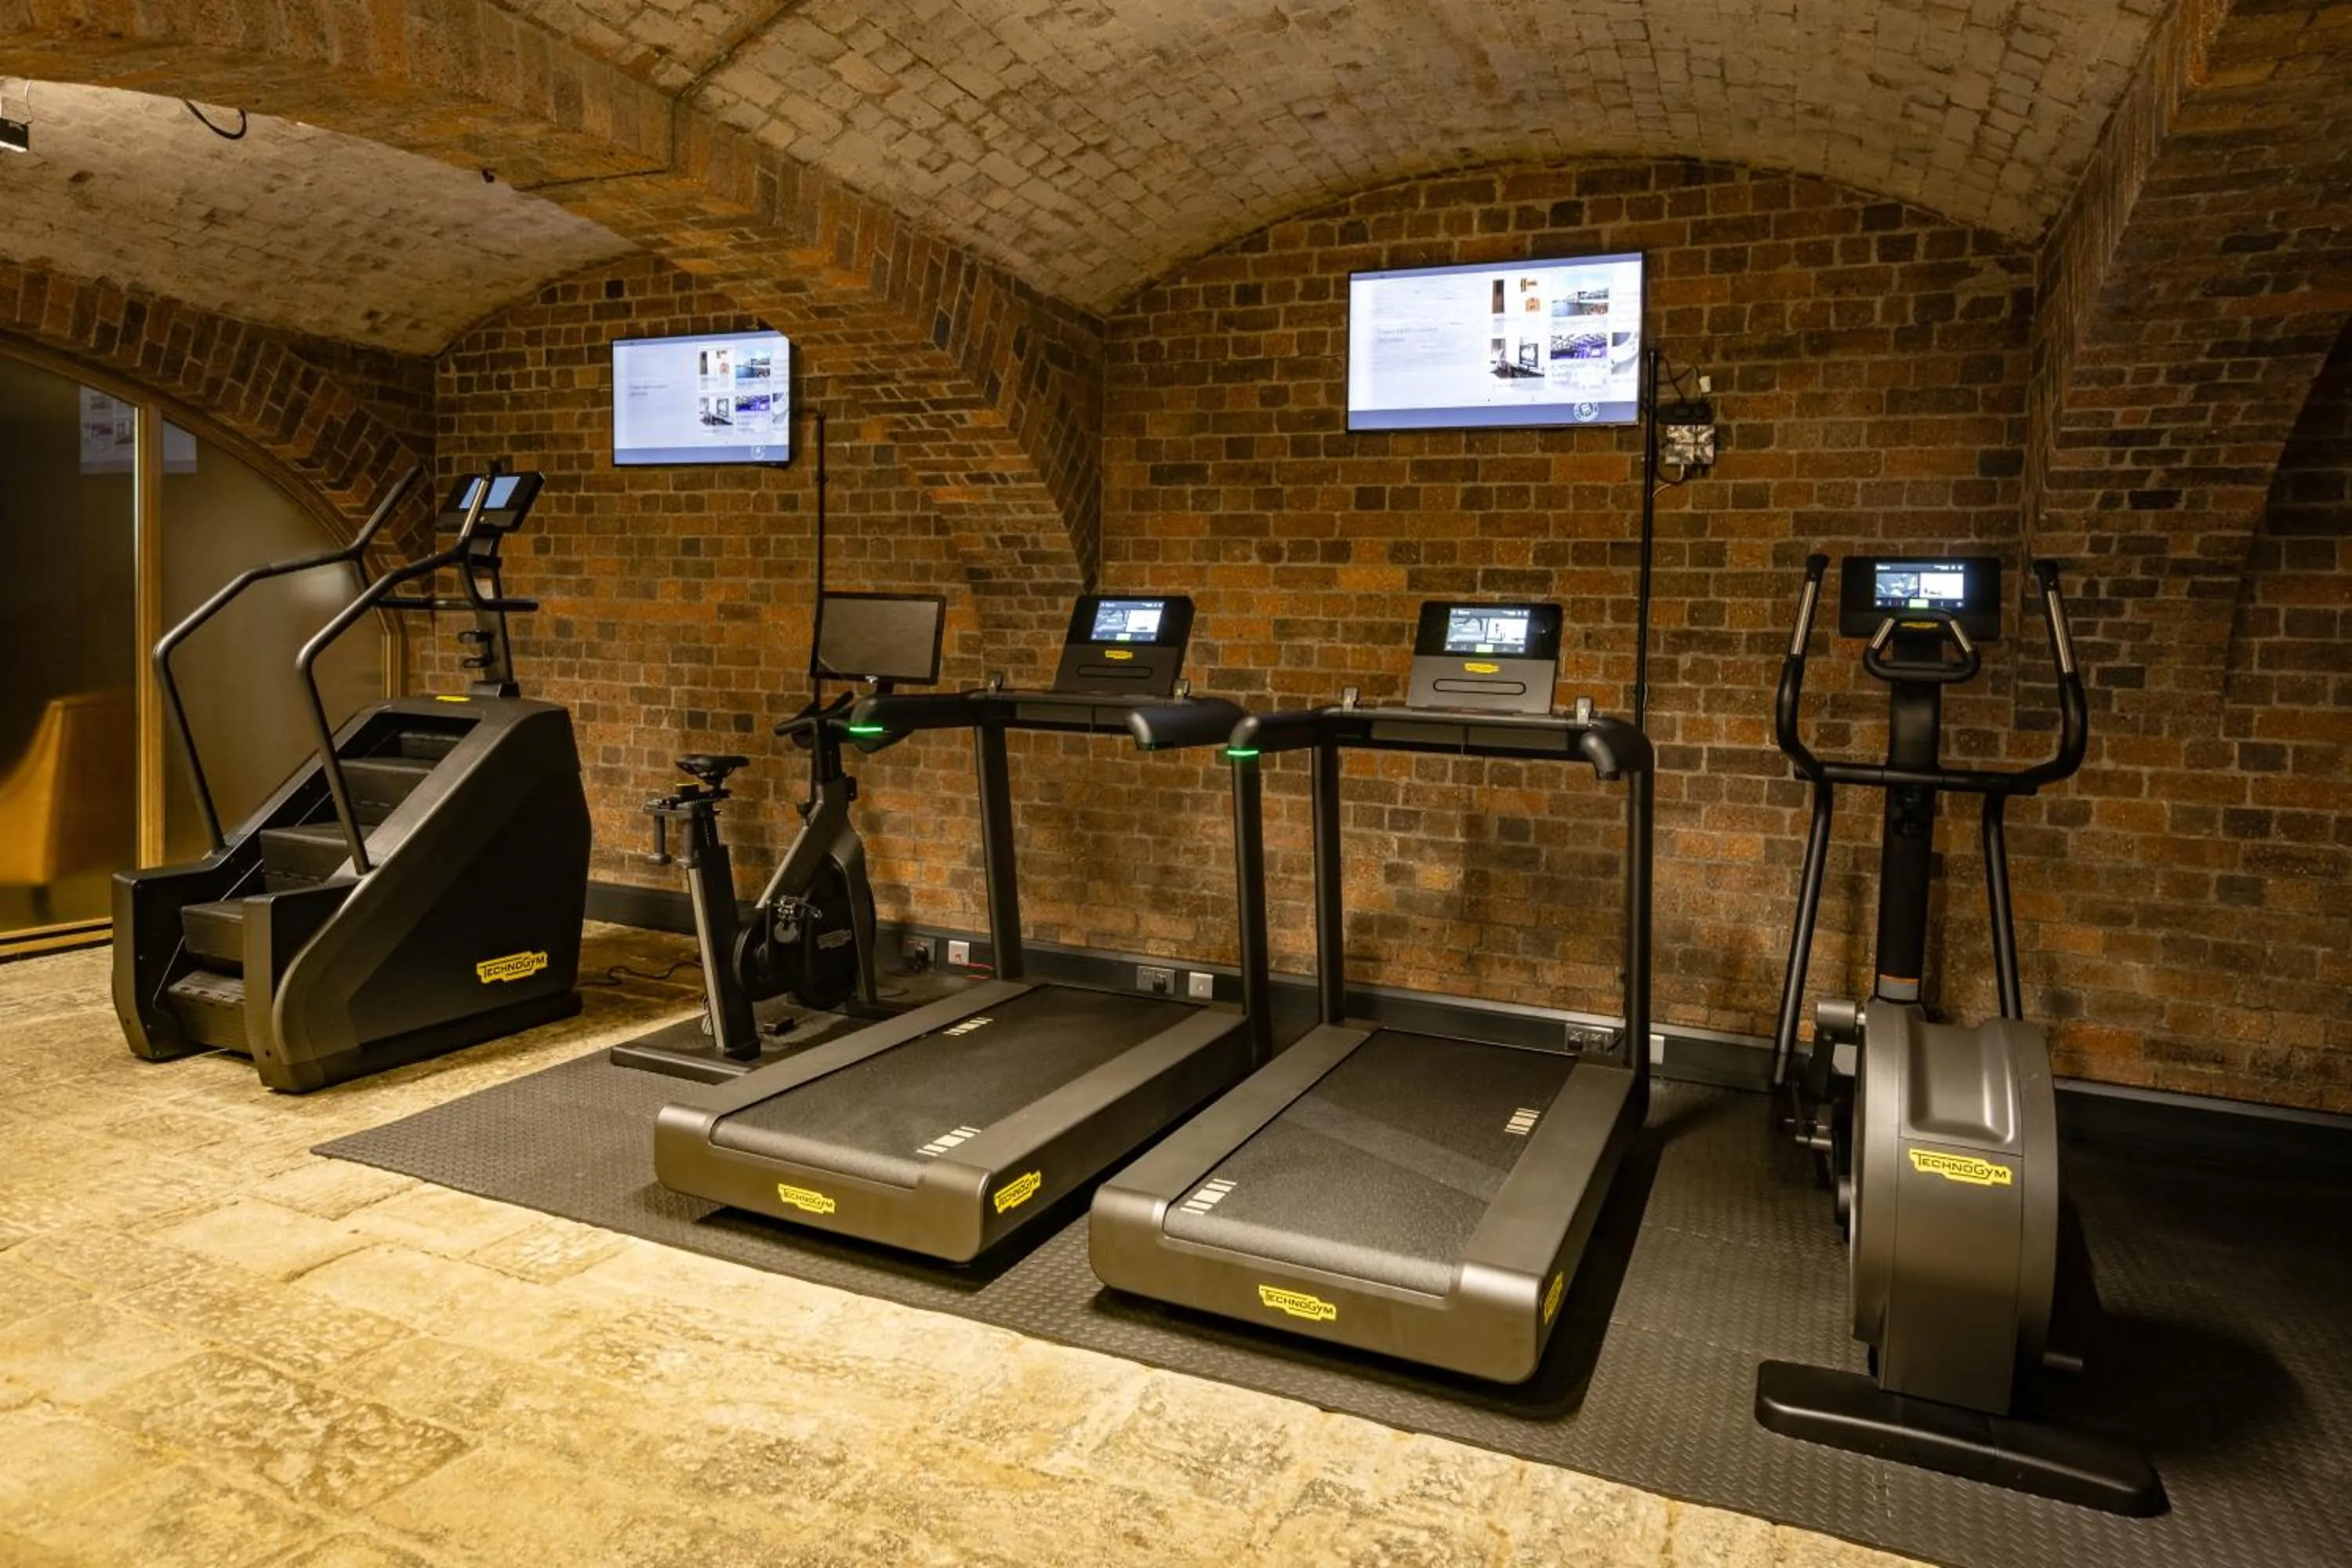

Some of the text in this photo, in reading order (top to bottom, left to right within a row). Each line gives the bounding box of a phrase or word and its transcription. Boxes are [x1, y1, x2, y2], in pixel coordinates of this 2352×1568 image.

[478, 955, 546, 979] TECHNOGYM
[1911, 1151, 2007, 1181] TECHNOGYM
[1260, 1287, 1334, 1316] TECHNOGYM
